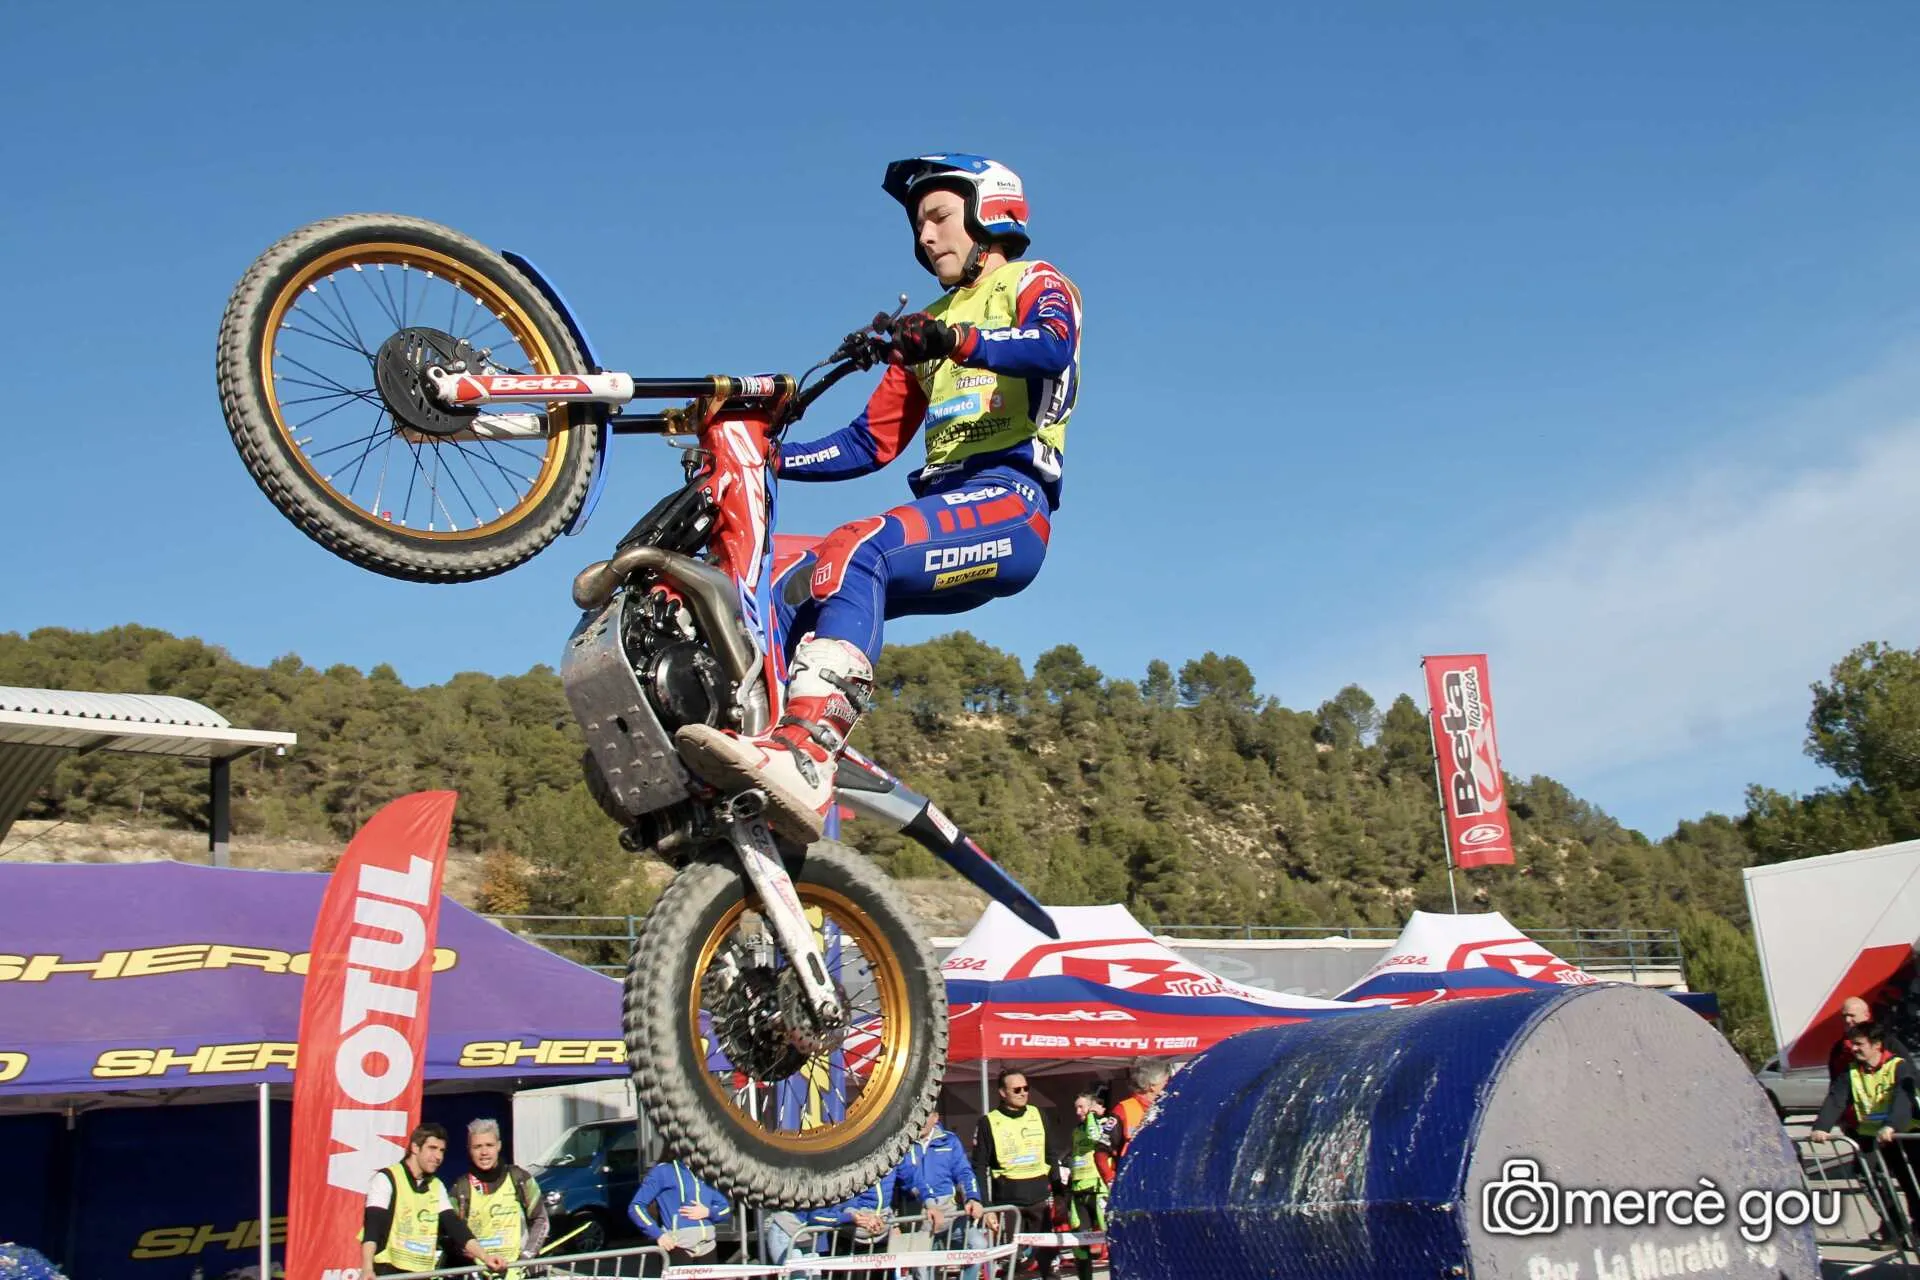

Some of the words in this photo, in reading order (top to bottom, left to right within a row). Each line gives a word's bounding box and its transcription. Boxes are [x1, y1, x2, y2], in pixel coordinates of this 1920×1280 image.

[489, 376, 580, 391] Beta
[934, 399, 975, 417] Marató
[784, 445, 841, 468] COMAS
[924, 537, 1013, 573] COMAS
[945, 566, 997, 584] DUNLOP
[1441, 671, 1483, 817] Beta
[327, 855, 434, 1196] MOTUL
[92, 1041, 299, 1078] SHER
[459, 1039, 628, 1067] SHER
[1629, 1232, 1730, 1280] Marató
